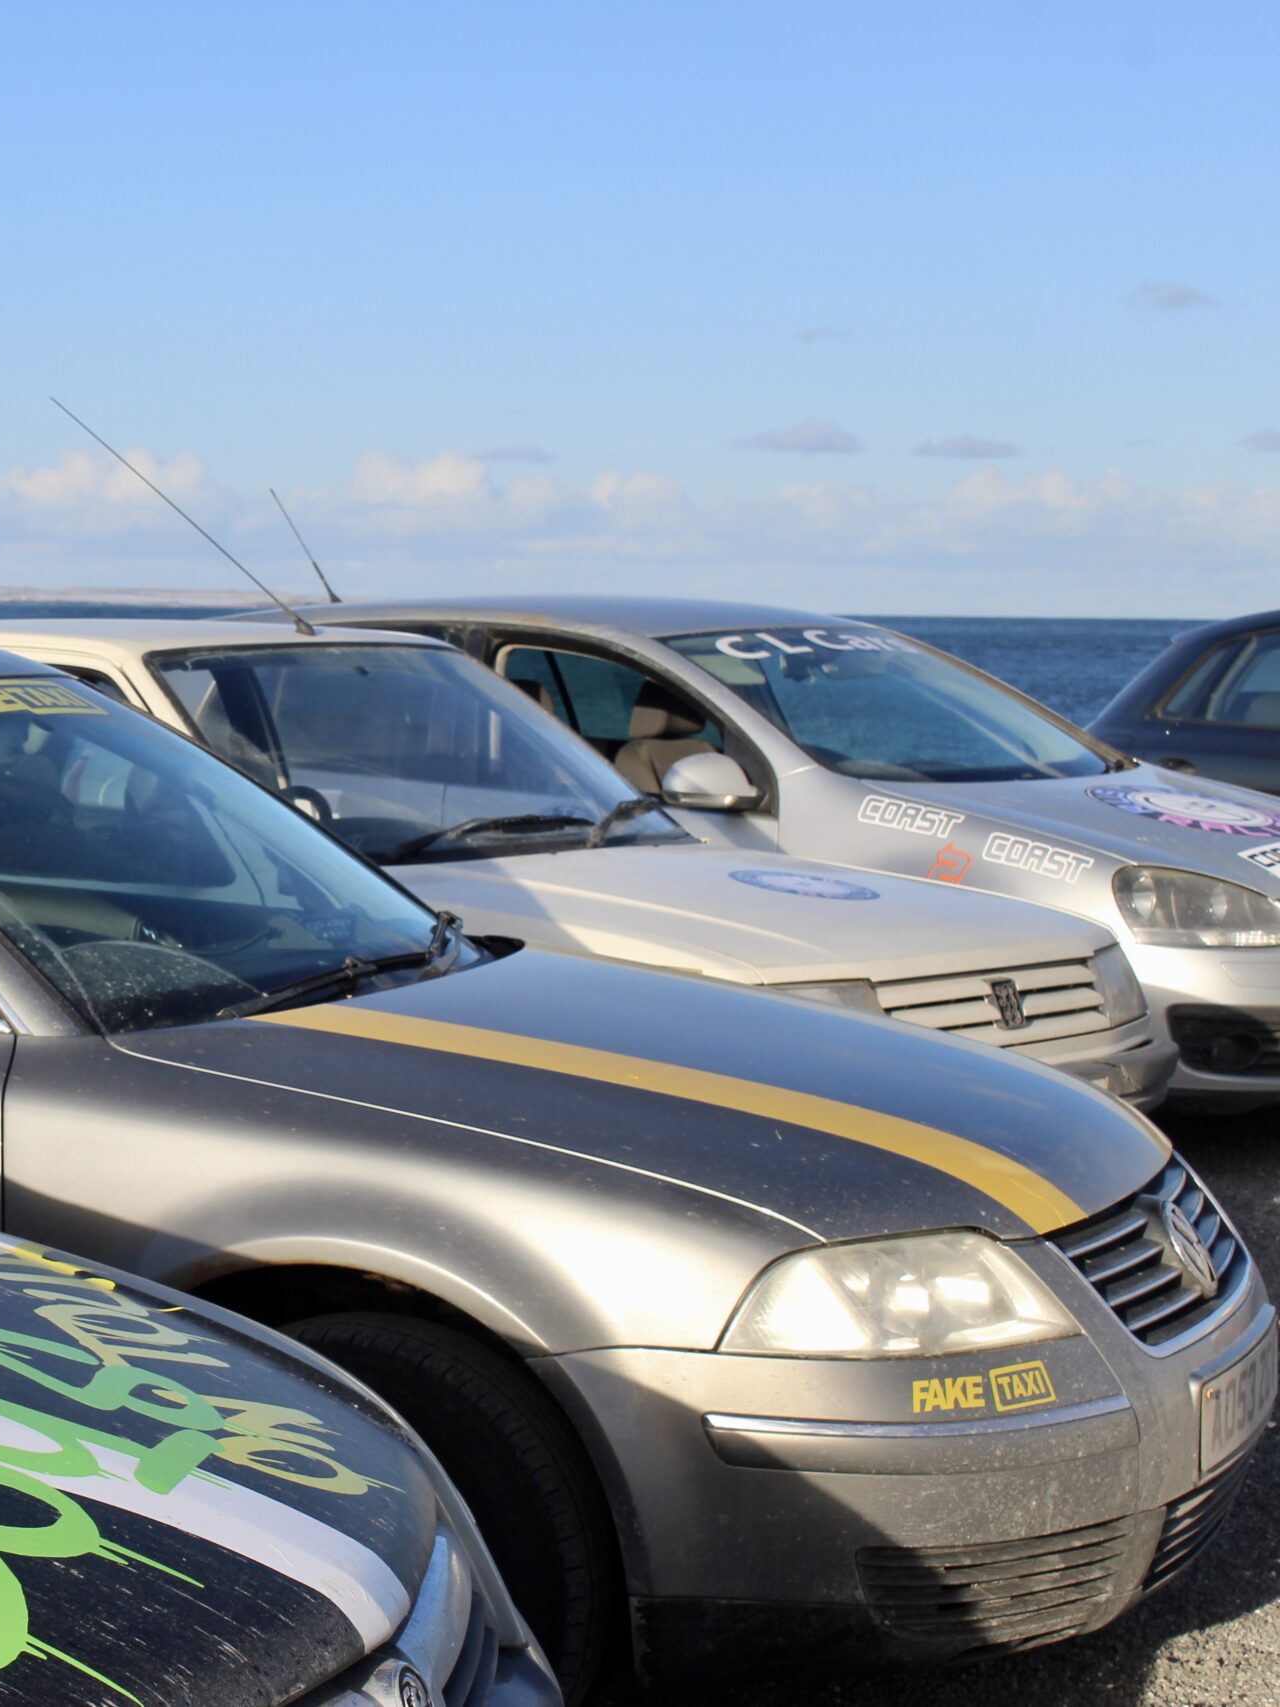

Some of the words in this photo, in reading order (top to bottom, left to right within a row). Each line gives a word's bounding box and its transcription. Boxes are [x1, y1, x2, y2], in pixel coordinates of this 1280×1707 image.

[857, 795, 965, 838] COAST
[928, 843, 973, 884] 2
[982, 831, 1094, 883] COAST
[913, 1375, 985, 1414] FAKE
